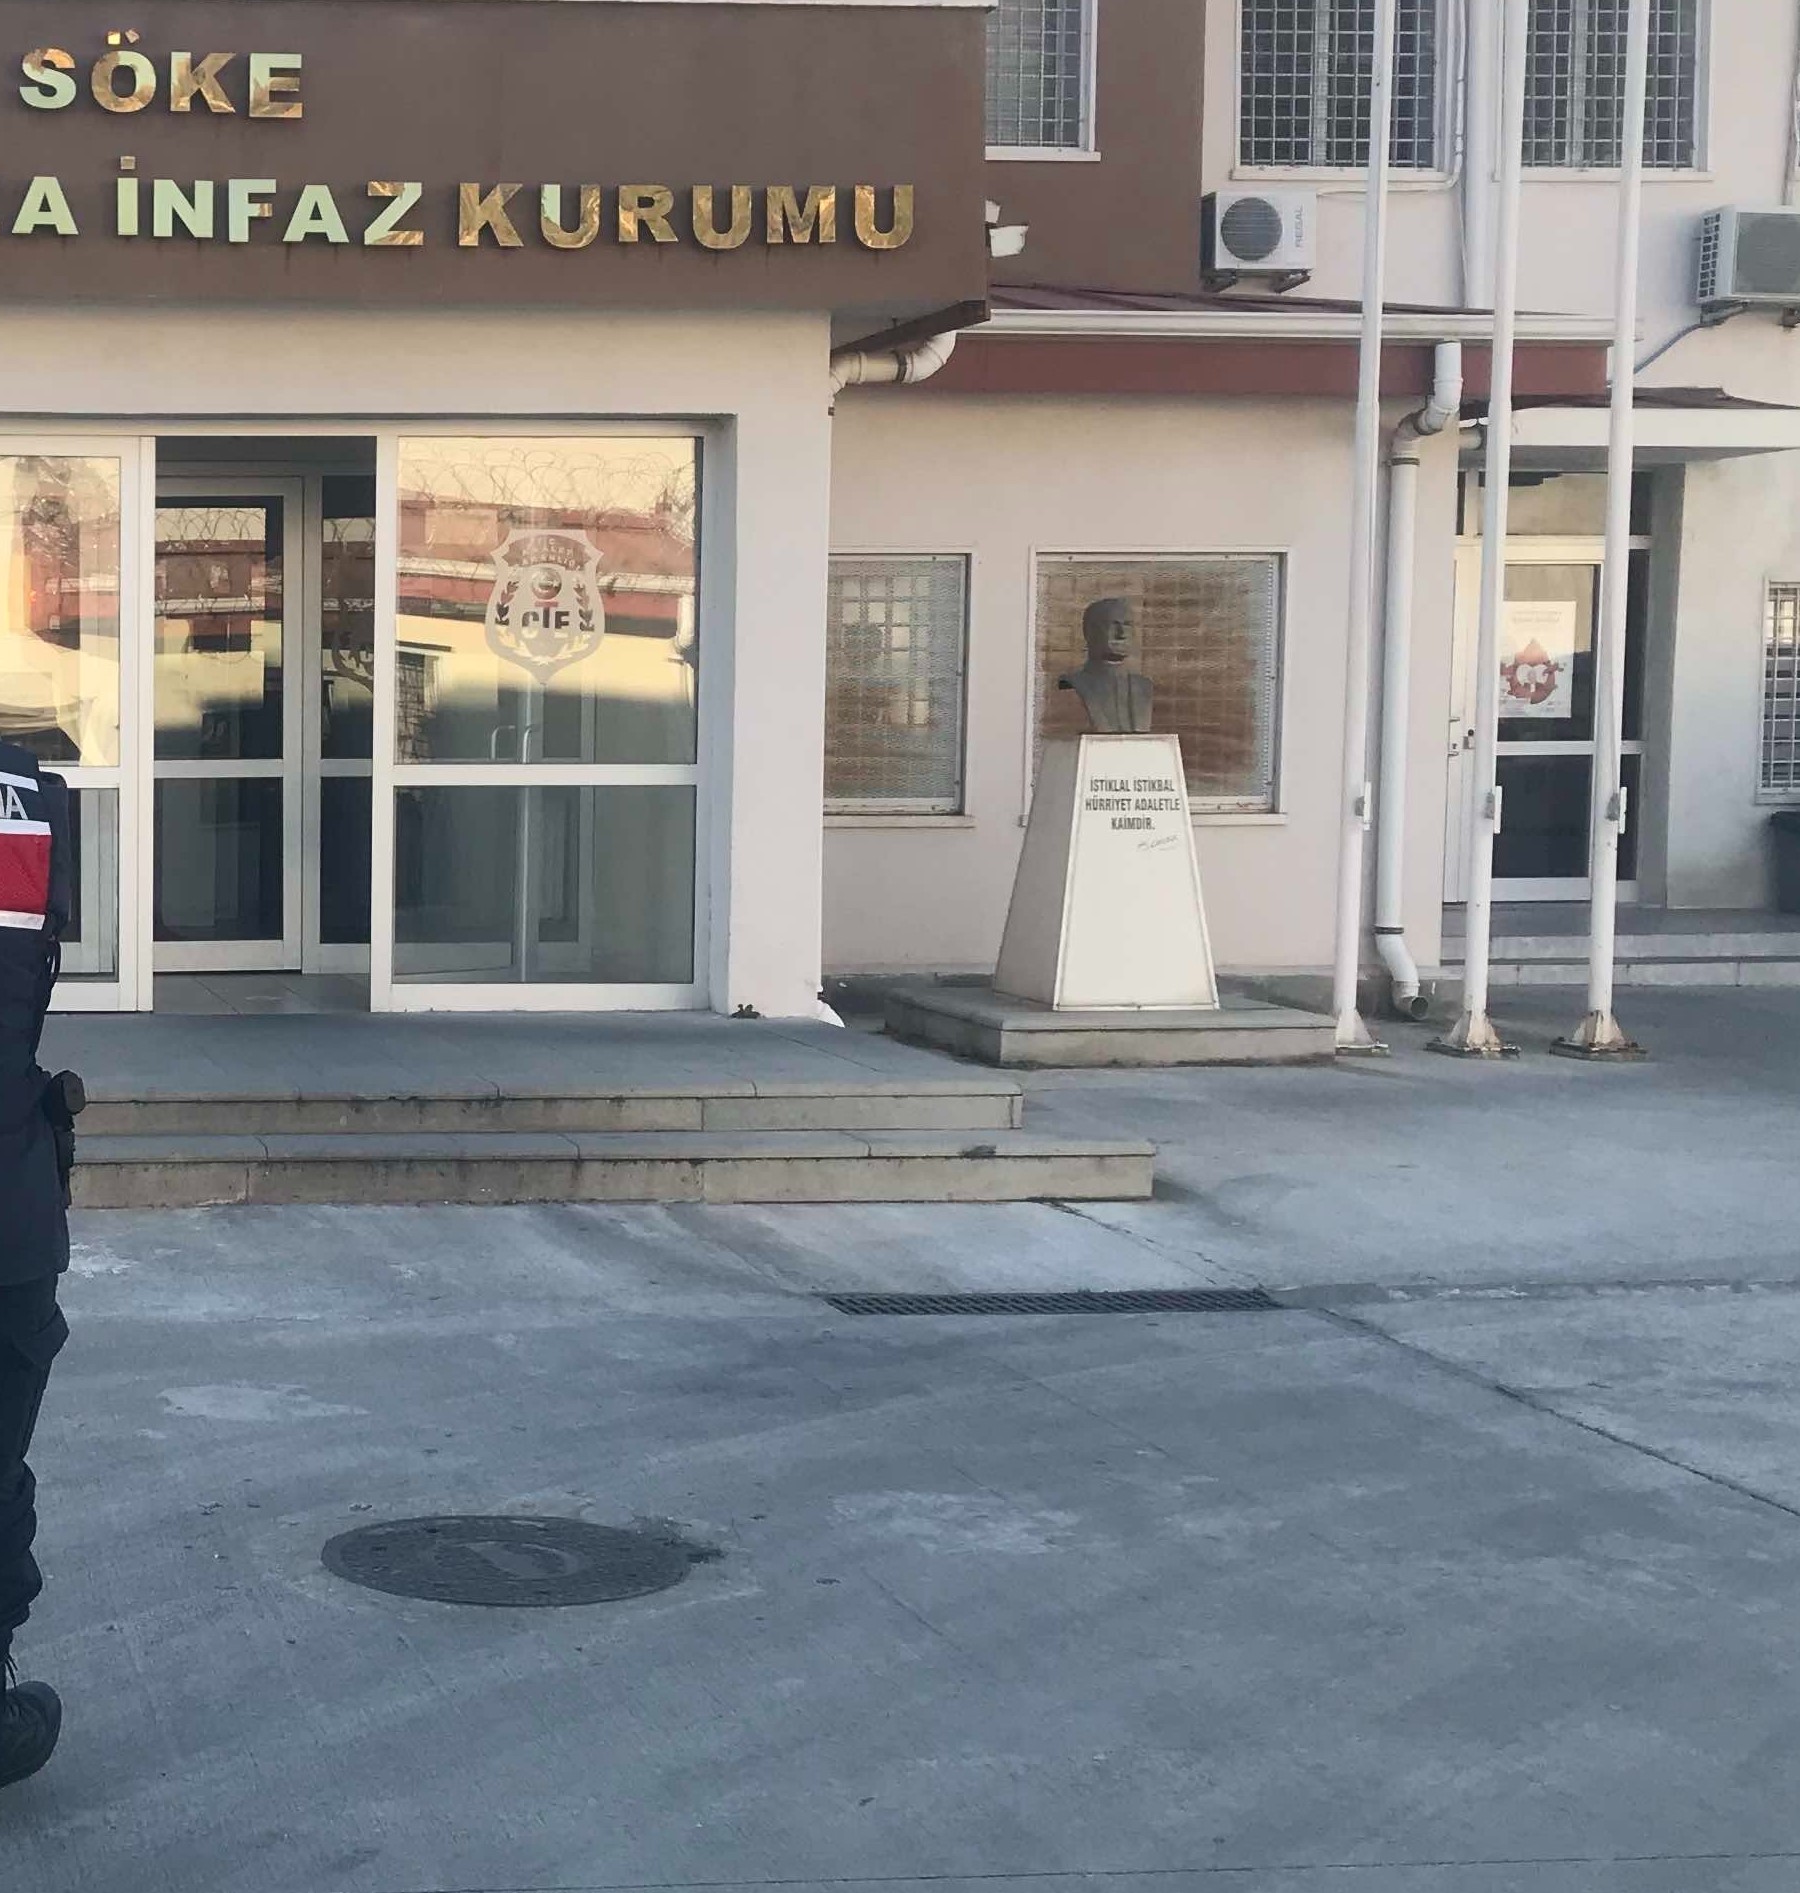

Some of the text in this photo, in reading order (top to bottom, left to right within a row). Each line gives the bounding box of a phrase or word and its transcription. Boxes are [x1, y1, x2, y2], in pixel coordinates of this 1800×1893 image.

[19, 28, 303, 118] SÖKE
[116, 155, 425, 246] İNFAZ
[458, 183, 915, 250] KURUMU
[1134, 798, 1180, 811] ADALETLE
